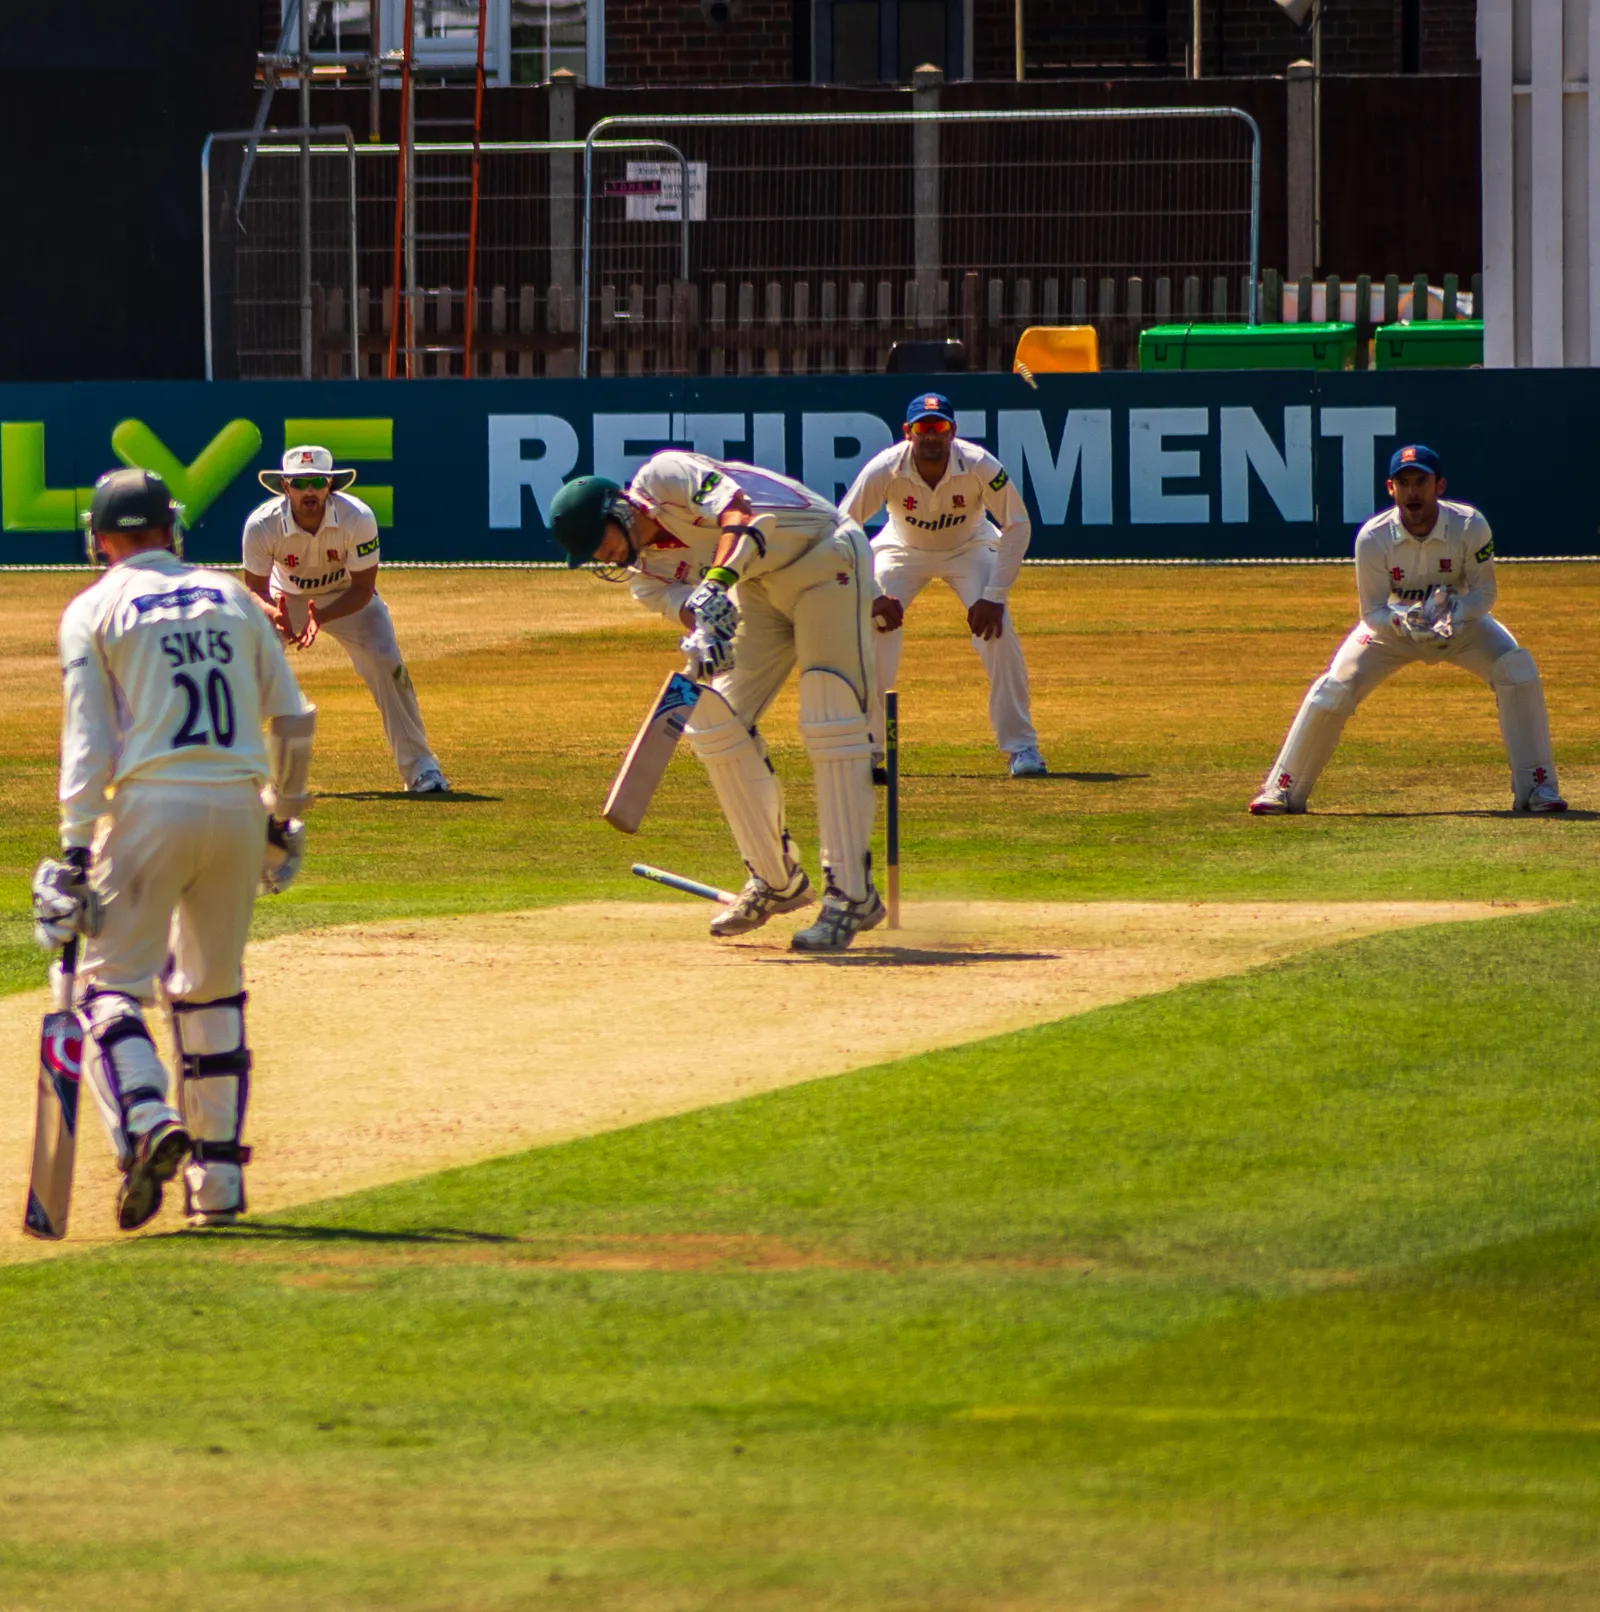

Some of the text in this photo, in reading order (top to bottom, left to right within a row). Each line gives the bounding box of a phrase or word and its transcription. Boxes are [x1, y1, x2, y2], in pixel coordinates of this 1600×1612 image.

[905, 512, 967, 531] amlin
[289, 568, 346, 589] amlin
[171, 668, 236, 749] 20
